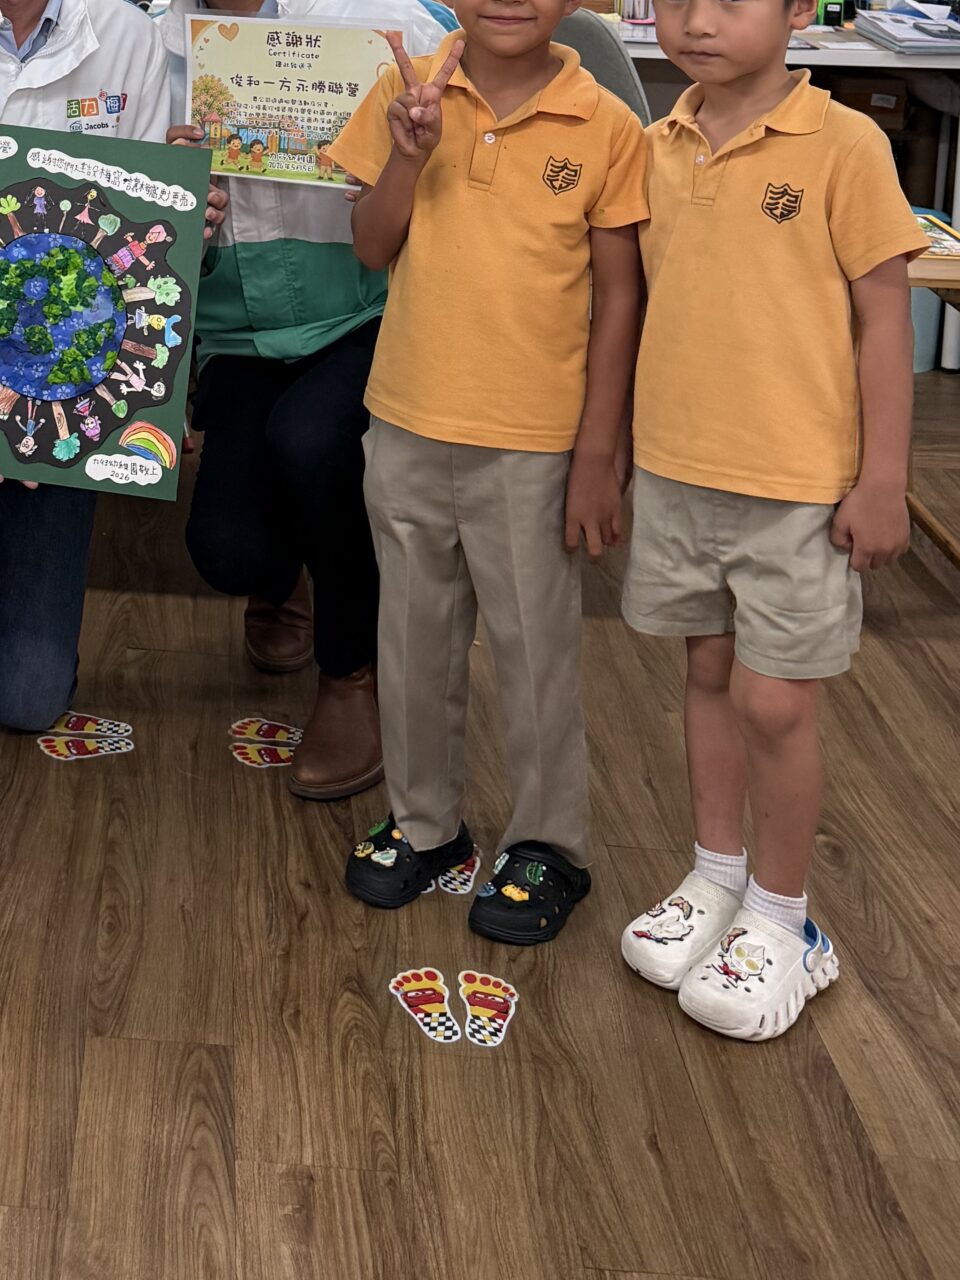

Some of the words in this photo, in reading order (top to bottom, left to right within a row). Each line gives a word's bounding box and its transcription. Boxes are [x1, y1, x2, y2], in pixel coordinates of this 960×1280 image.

[266, 31, 322, 48] 感謝狀
[268, 49, 320, 60] Certificate
[67, 99, 99, 117] 活力
[84, 122, 109, 130] Jacobs
[109, 470, 130, 481] 2026
